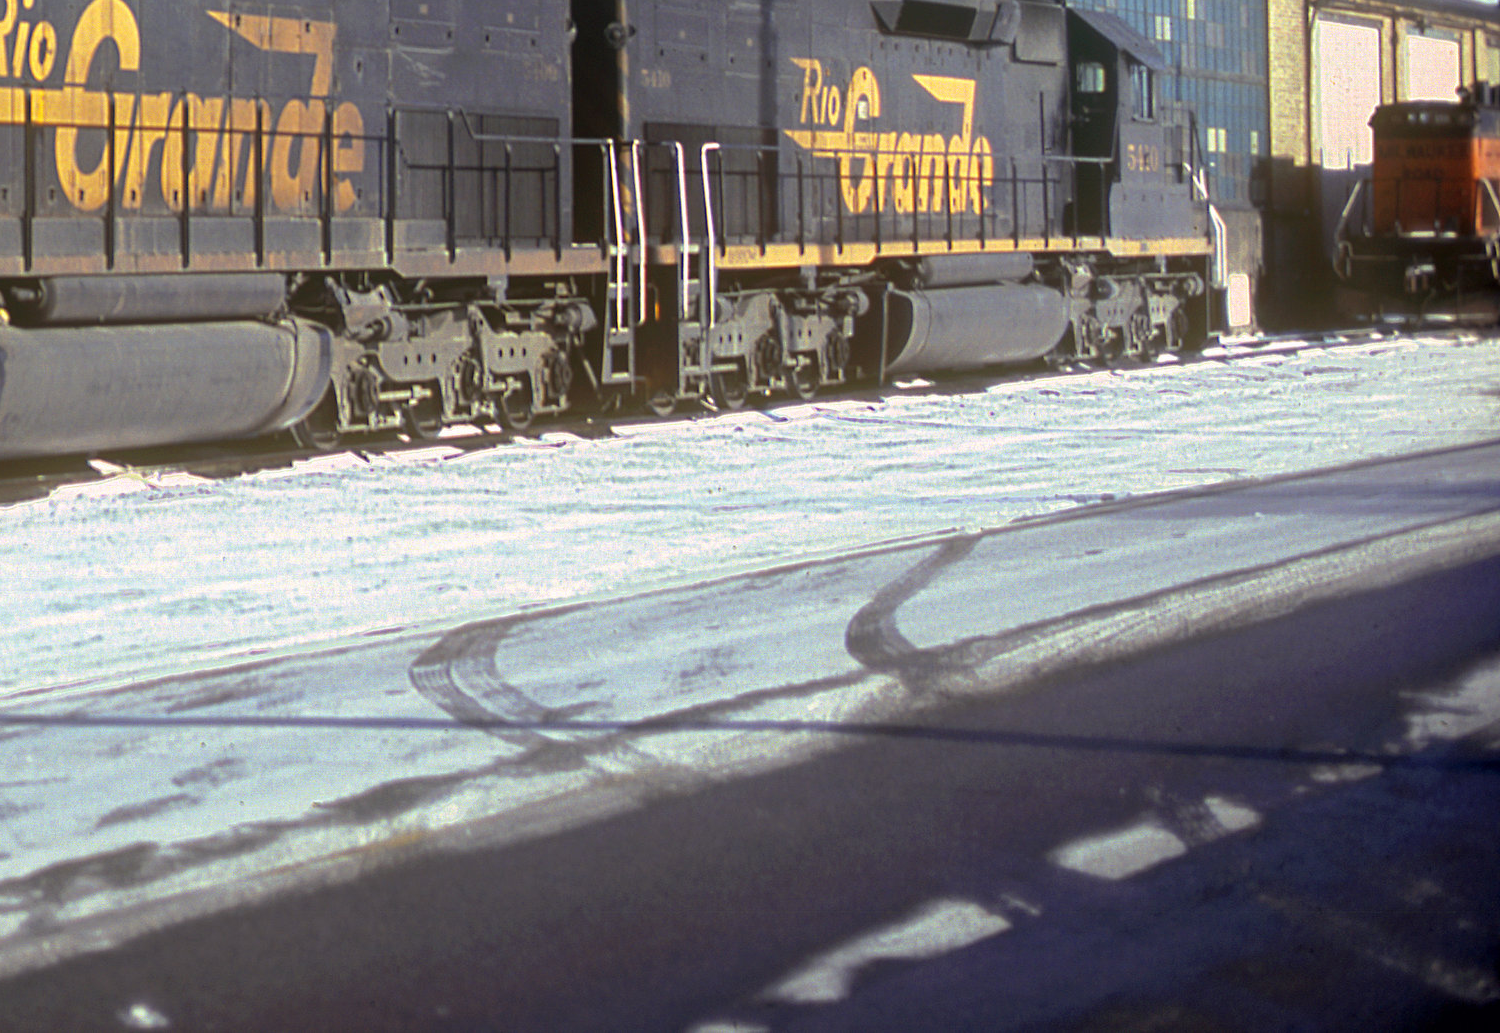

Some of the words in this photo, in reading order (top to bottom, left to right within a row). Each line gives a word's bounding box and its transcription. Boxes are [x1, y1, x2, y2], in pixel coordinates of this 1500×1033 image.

[789, 57, 841, 126] Rio
[782, 66, 994, 215] Grande
[1127, 143, 1159, 172] 5410
